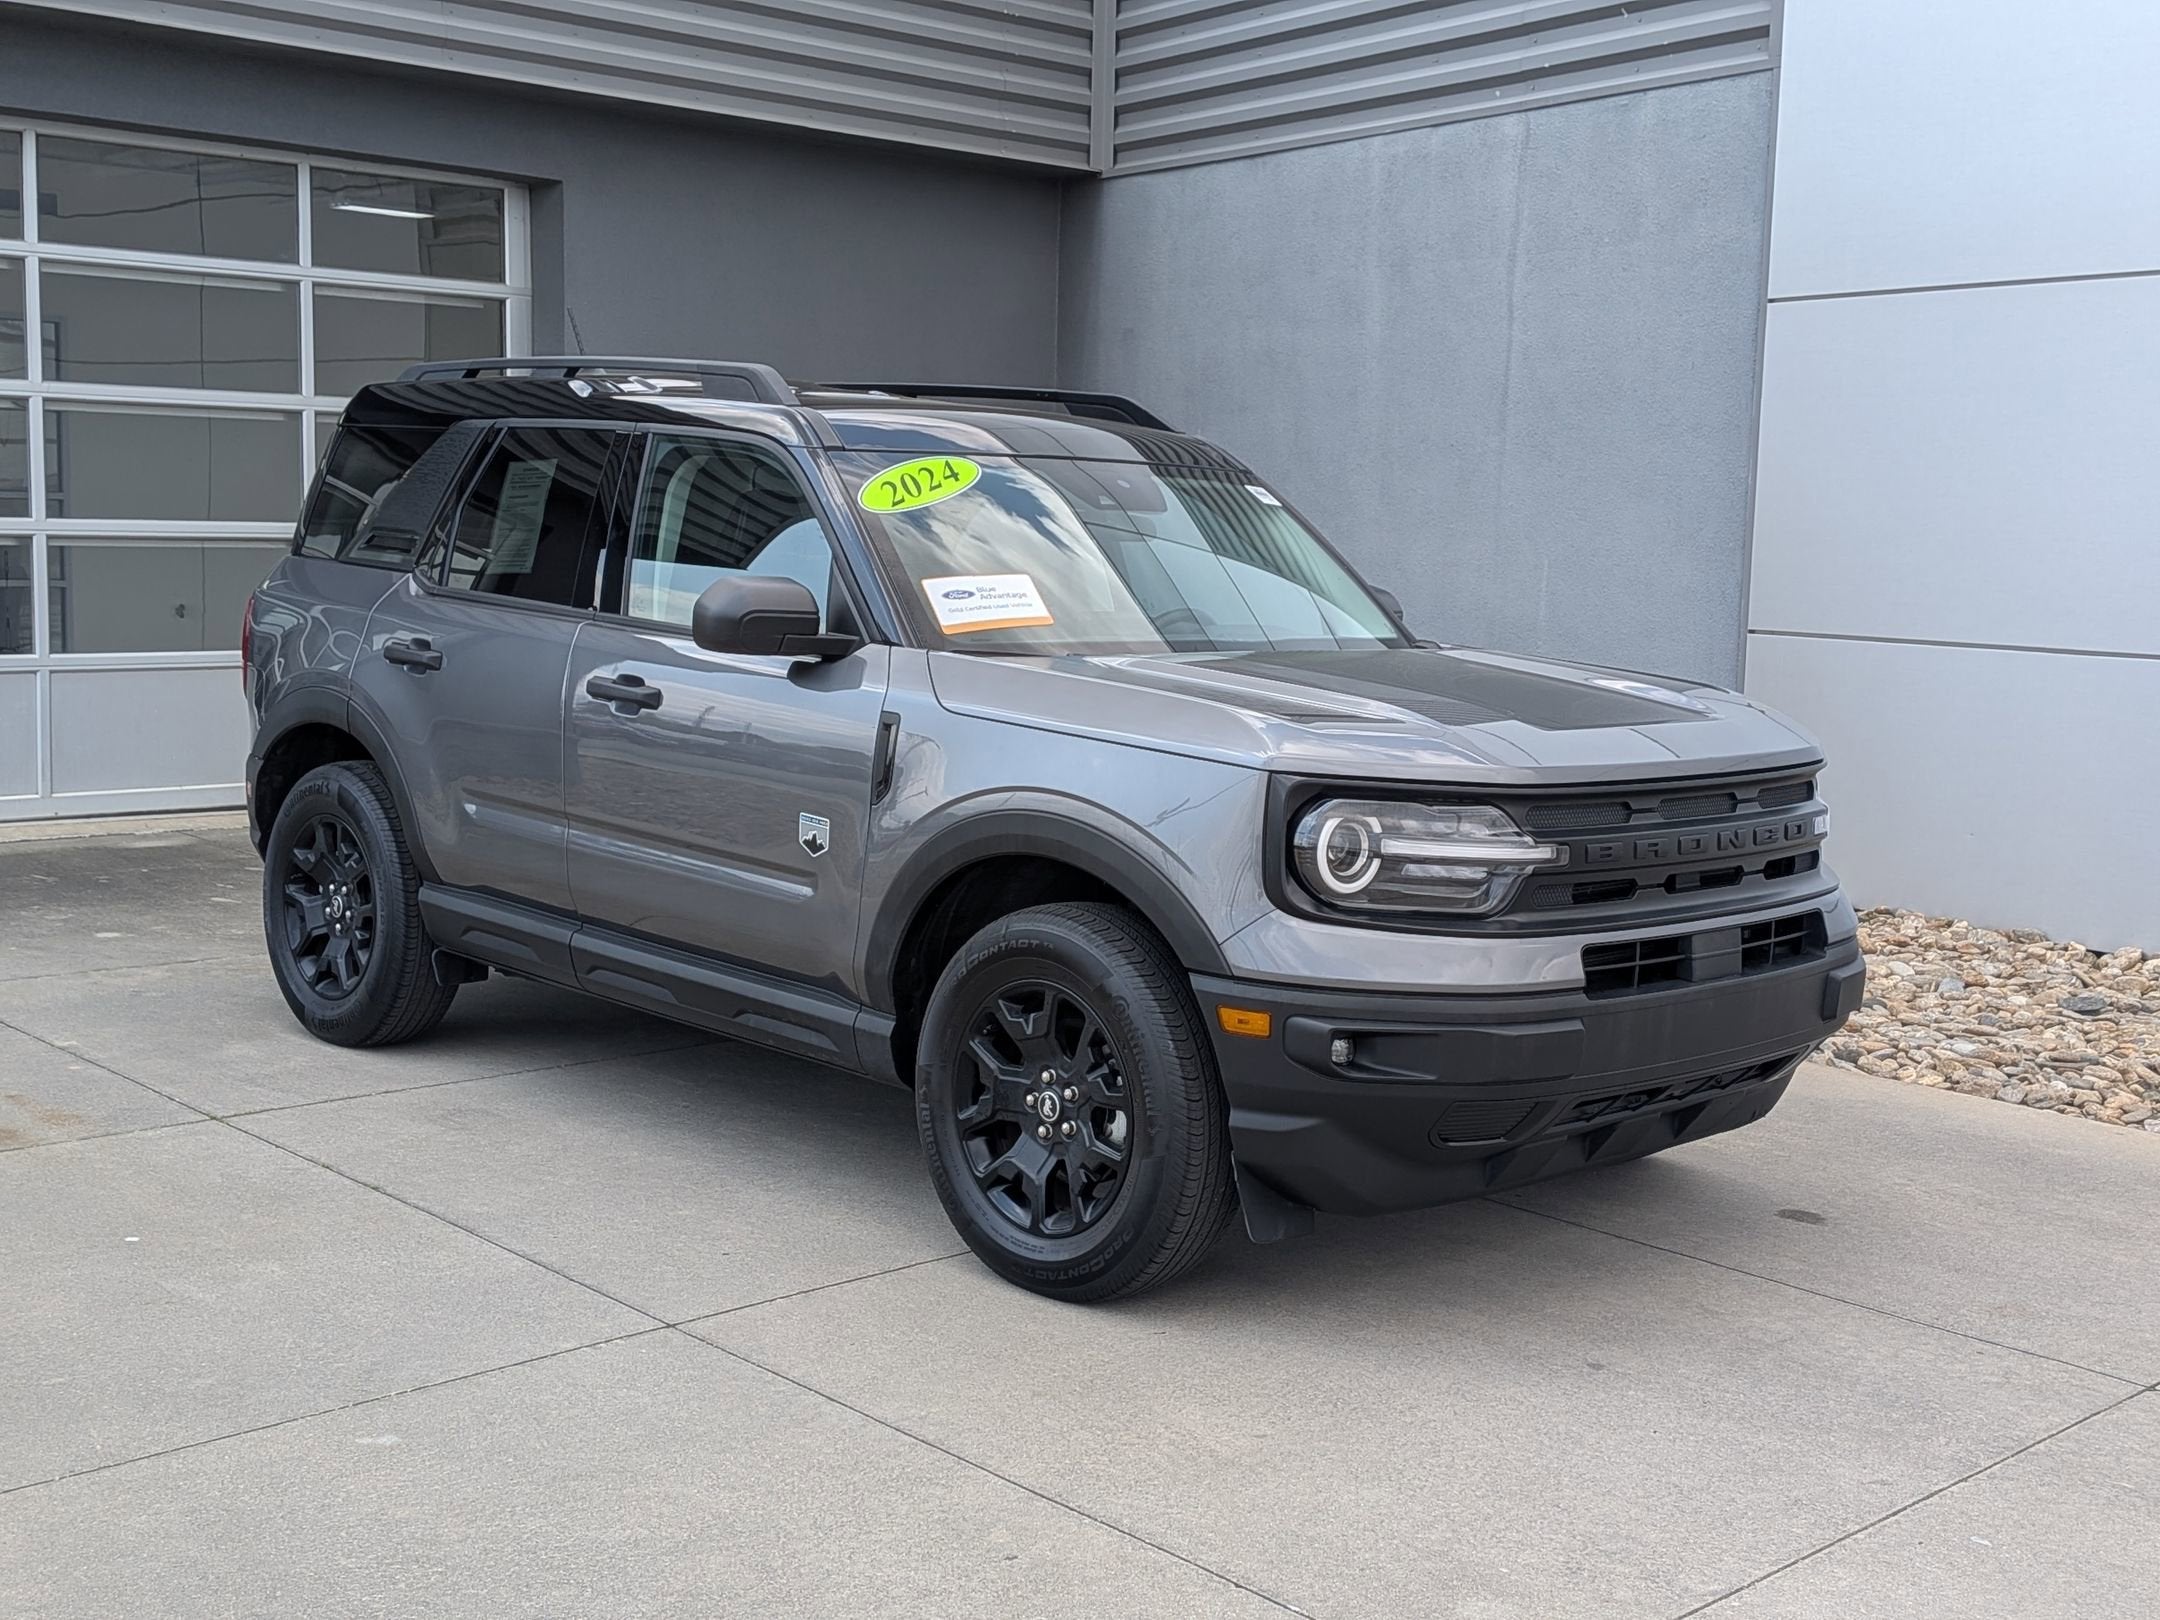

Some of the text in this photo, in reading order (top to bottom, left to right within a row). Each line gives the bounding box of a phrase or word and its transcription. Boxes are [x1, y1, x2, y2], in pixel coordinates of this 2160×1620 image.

[880, 459, 960, 508] 2024
[980, 592, 1028, 600] Advantage
[1585, 818, 1807, 864] BRONCO
